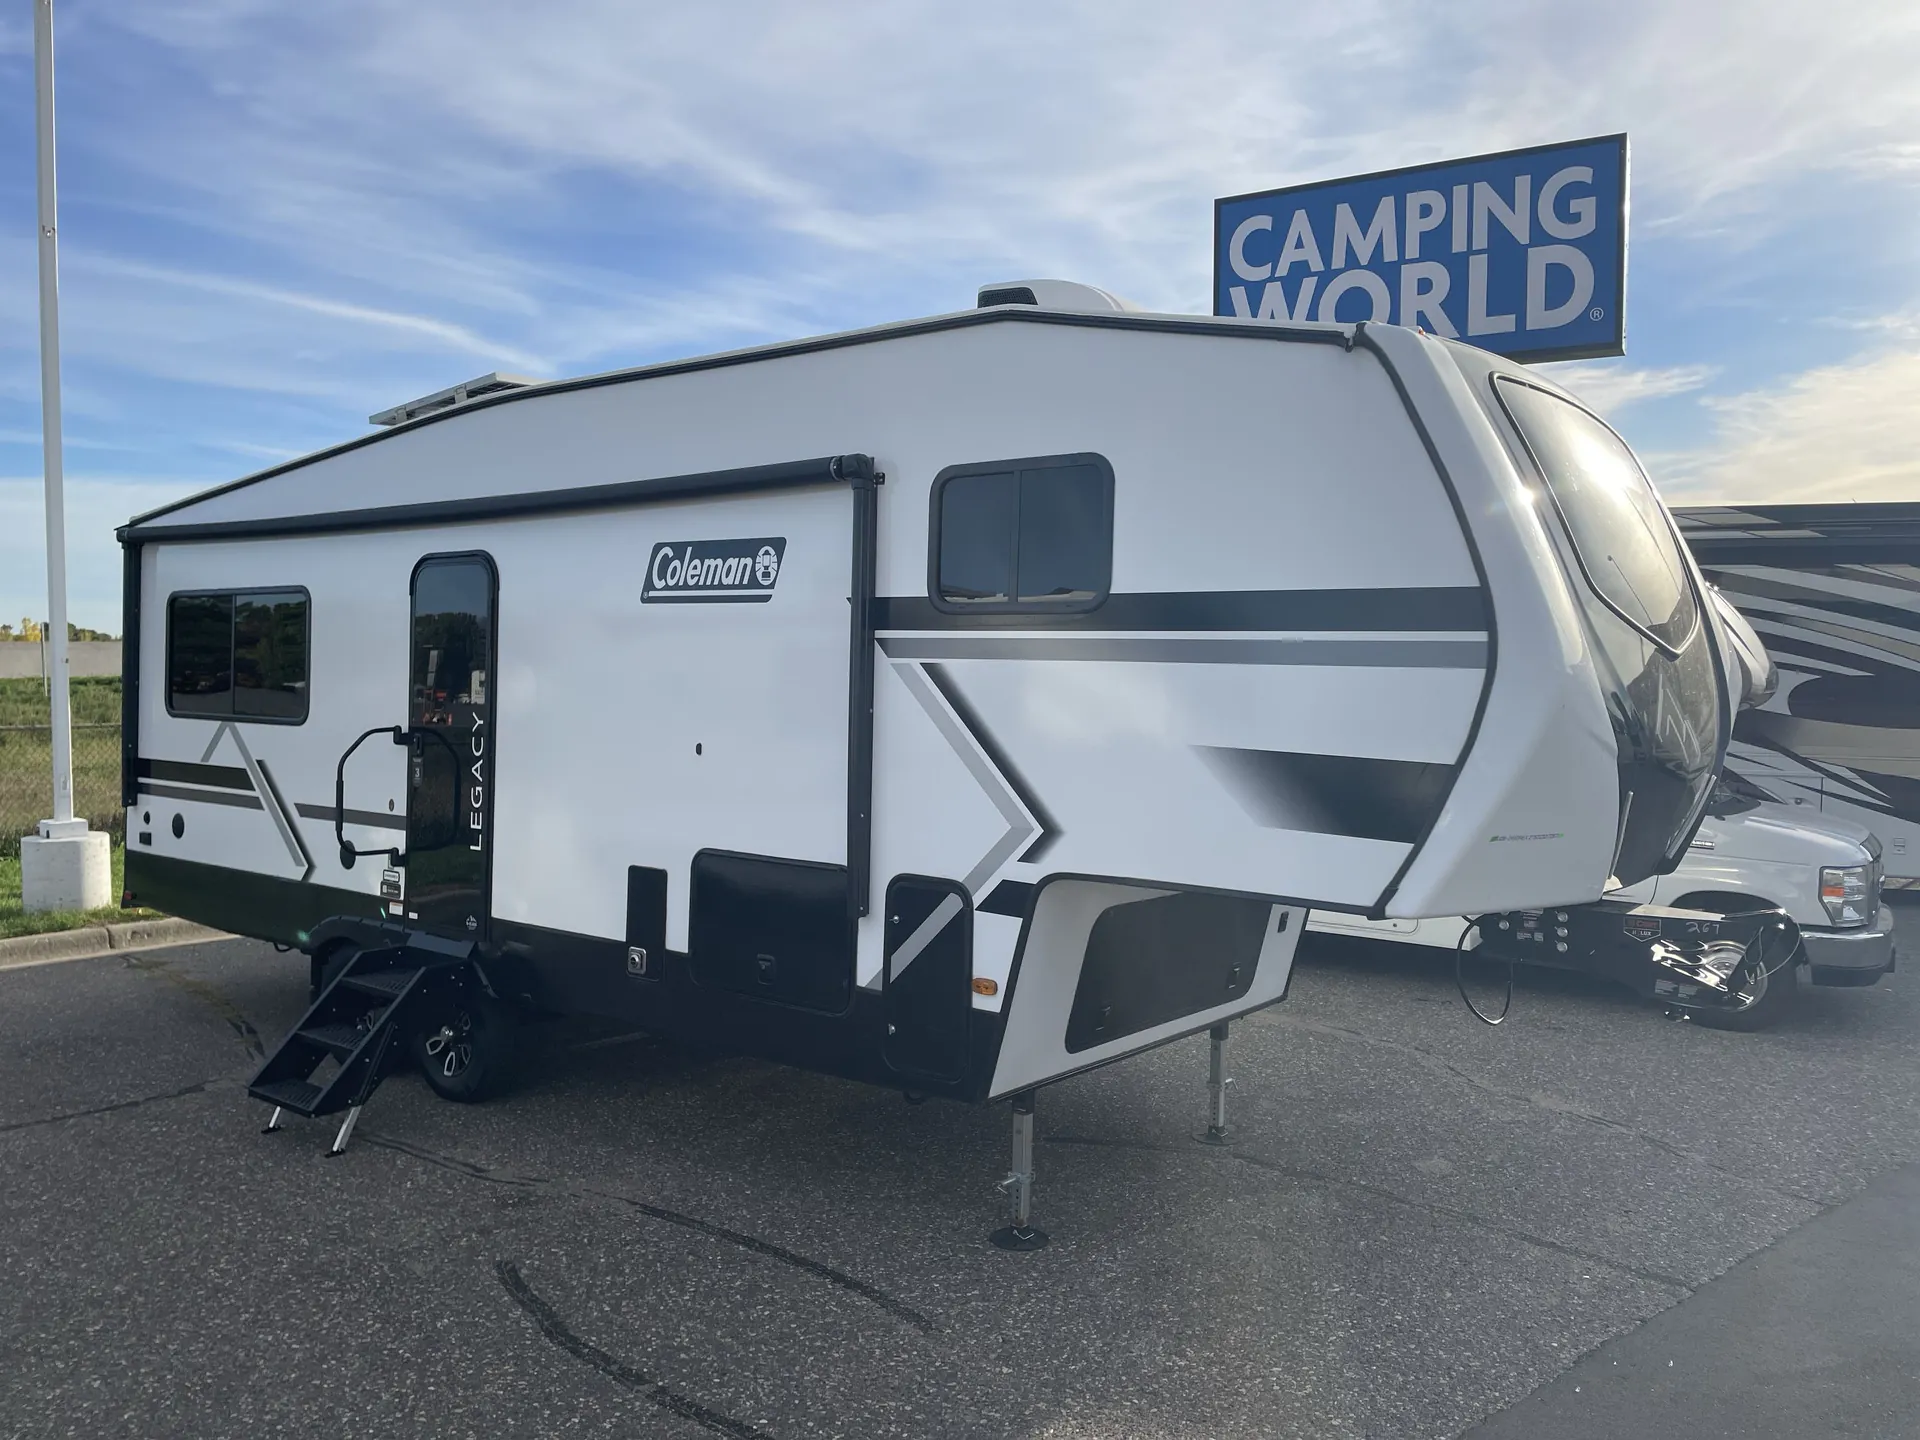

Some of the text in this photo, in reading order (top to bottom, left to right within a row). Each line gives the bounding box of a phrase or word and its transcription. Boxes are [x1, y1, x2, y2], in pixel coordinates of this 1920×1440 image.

[1229, 166, 1597, 282] CAMPING
[652, 546, 753, 589] Coleman
[469, 711, 484, 851] LEGACY
[1686, 922, 1720, 934] 267
